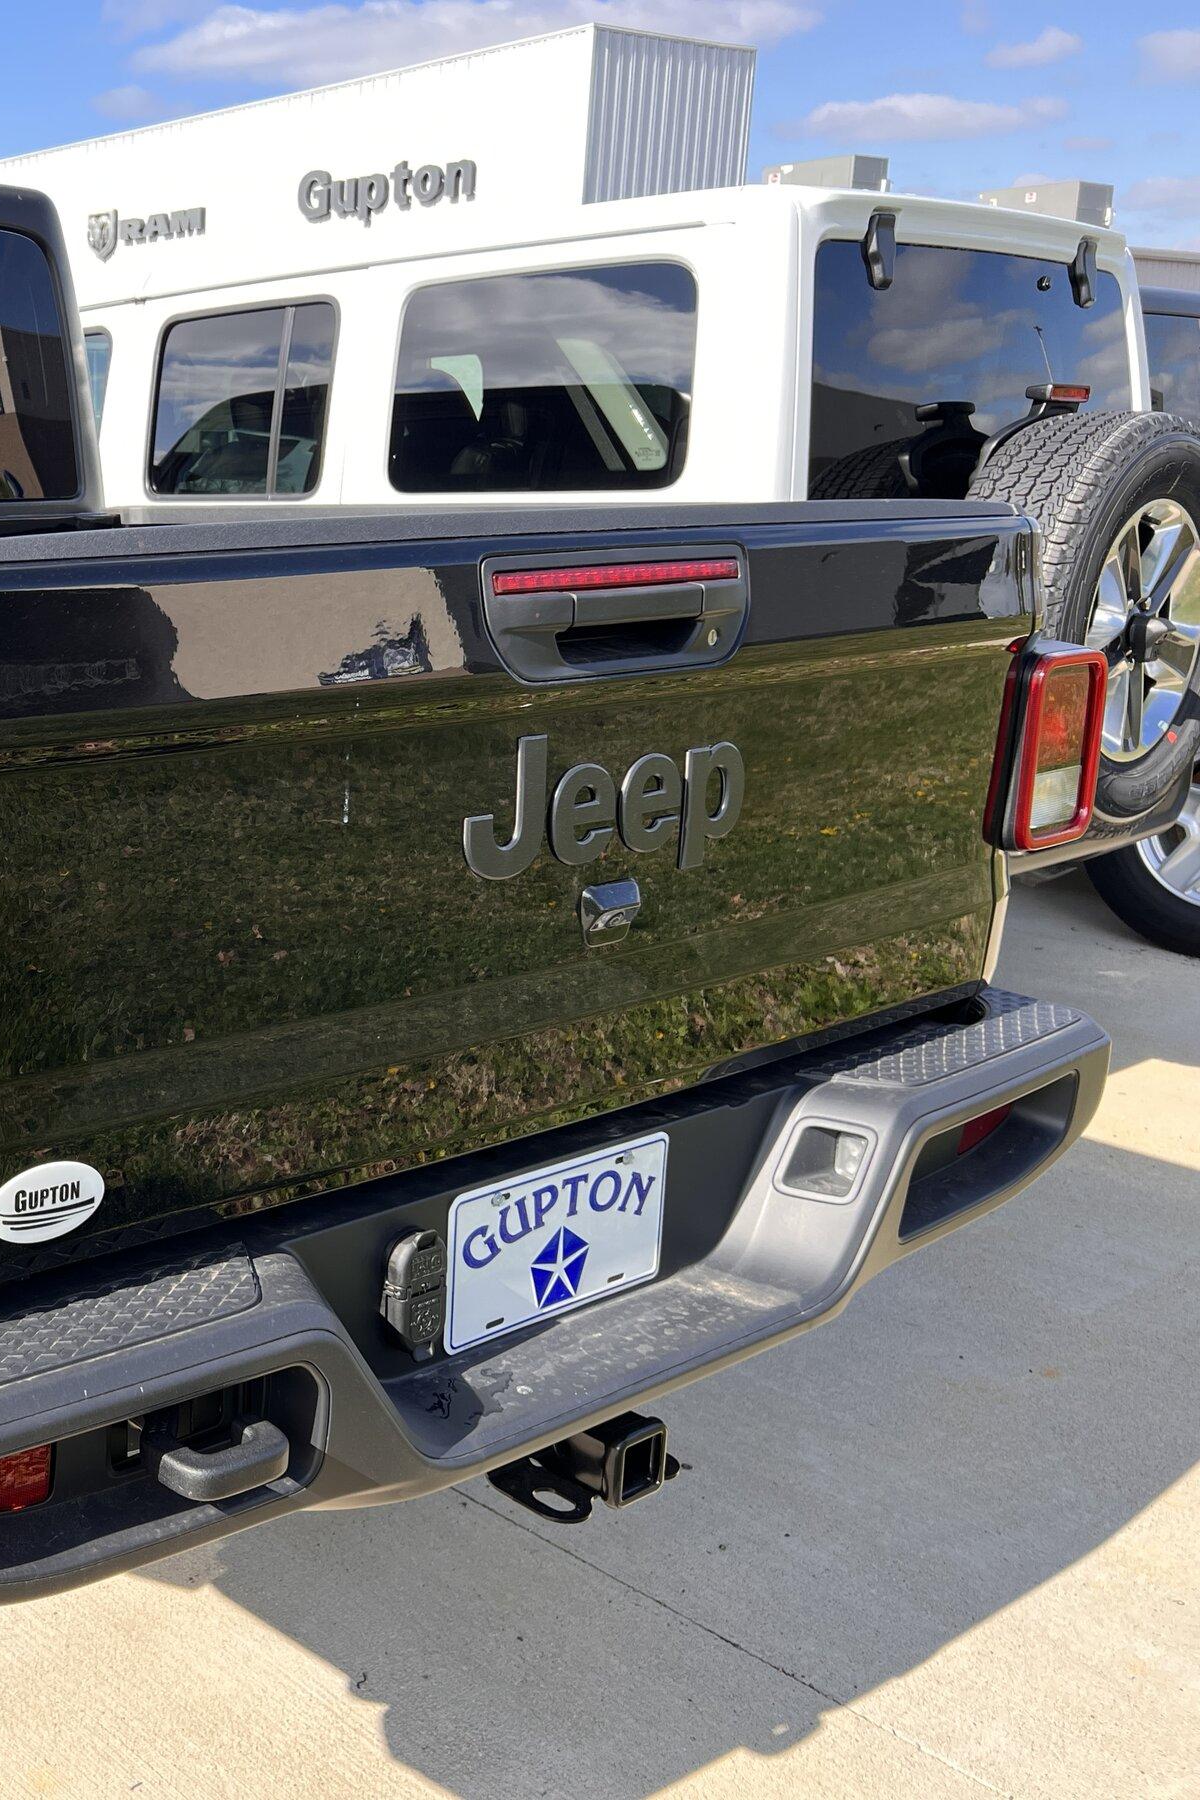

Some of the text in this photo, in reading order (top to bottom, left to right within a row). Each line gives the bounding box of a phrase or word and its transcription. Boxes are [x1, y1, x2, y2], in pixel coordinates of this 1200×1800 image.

[299, 160, 477, 226] Gupton
[118, 207, 206, 246] RAM
[463, 734, 745, 881] Jeep
[14, 1180, 81, 1213] GUPTON
[462, 1170, 655, 1269] GUPTON
